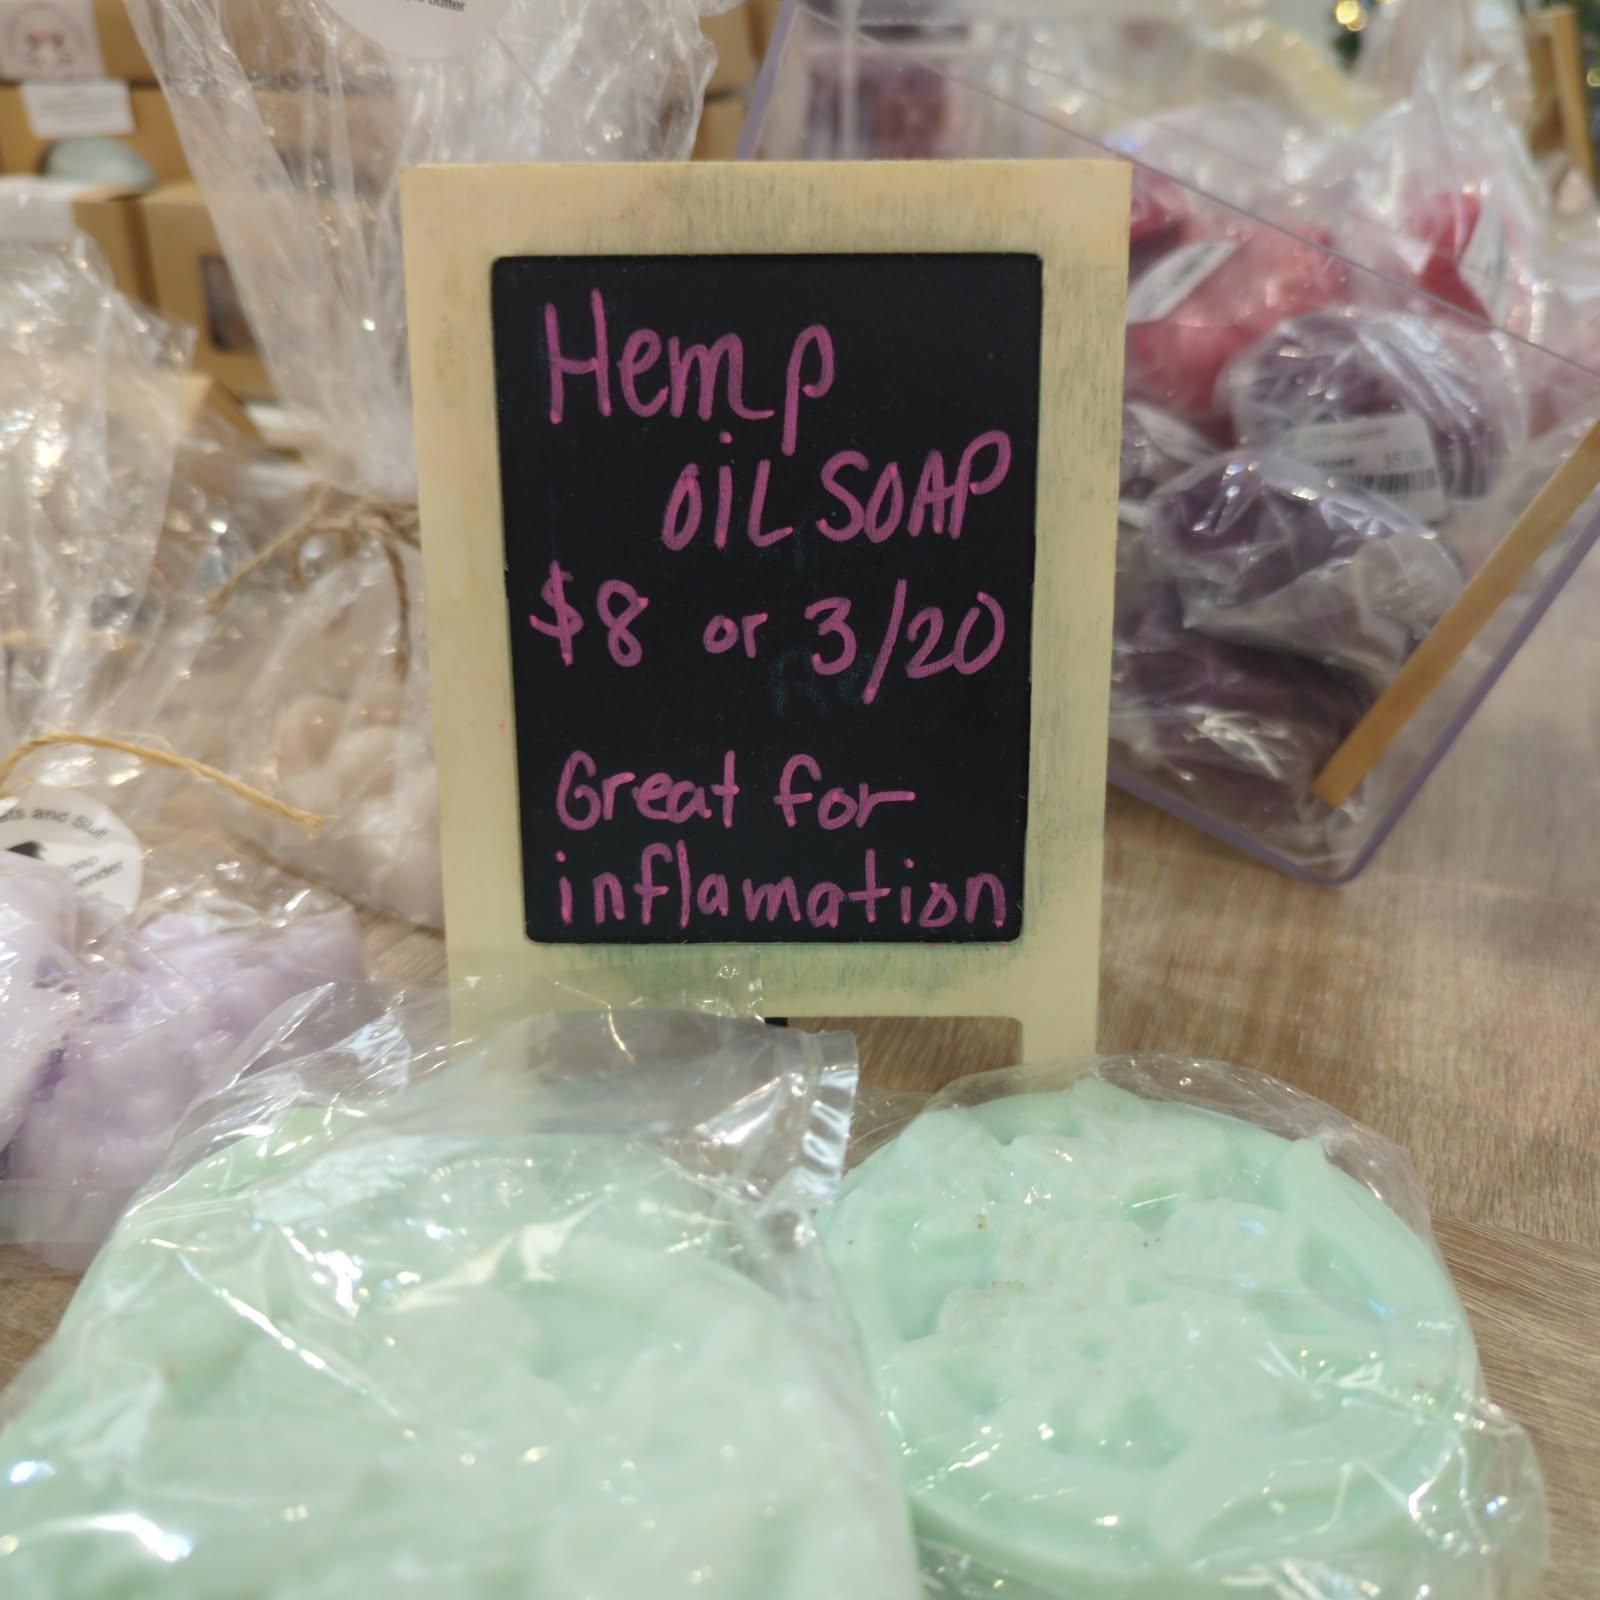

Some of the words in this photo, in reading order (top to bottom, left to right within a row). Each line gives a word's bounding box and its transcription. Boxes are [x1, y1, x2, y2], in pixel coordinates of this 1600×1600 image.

[545, 289, 835, 456] Hemp
[816, 430, 1012, 542] SOAP
[529, 560, 649, 667] $8
[703, 612, 768, 658] or
[805, 578, 1006, 706] 3/20
[556, 750, 740, 831] Great
[774, 754, 916, 829] for
[552, 839, 1008, 928] inflamation
